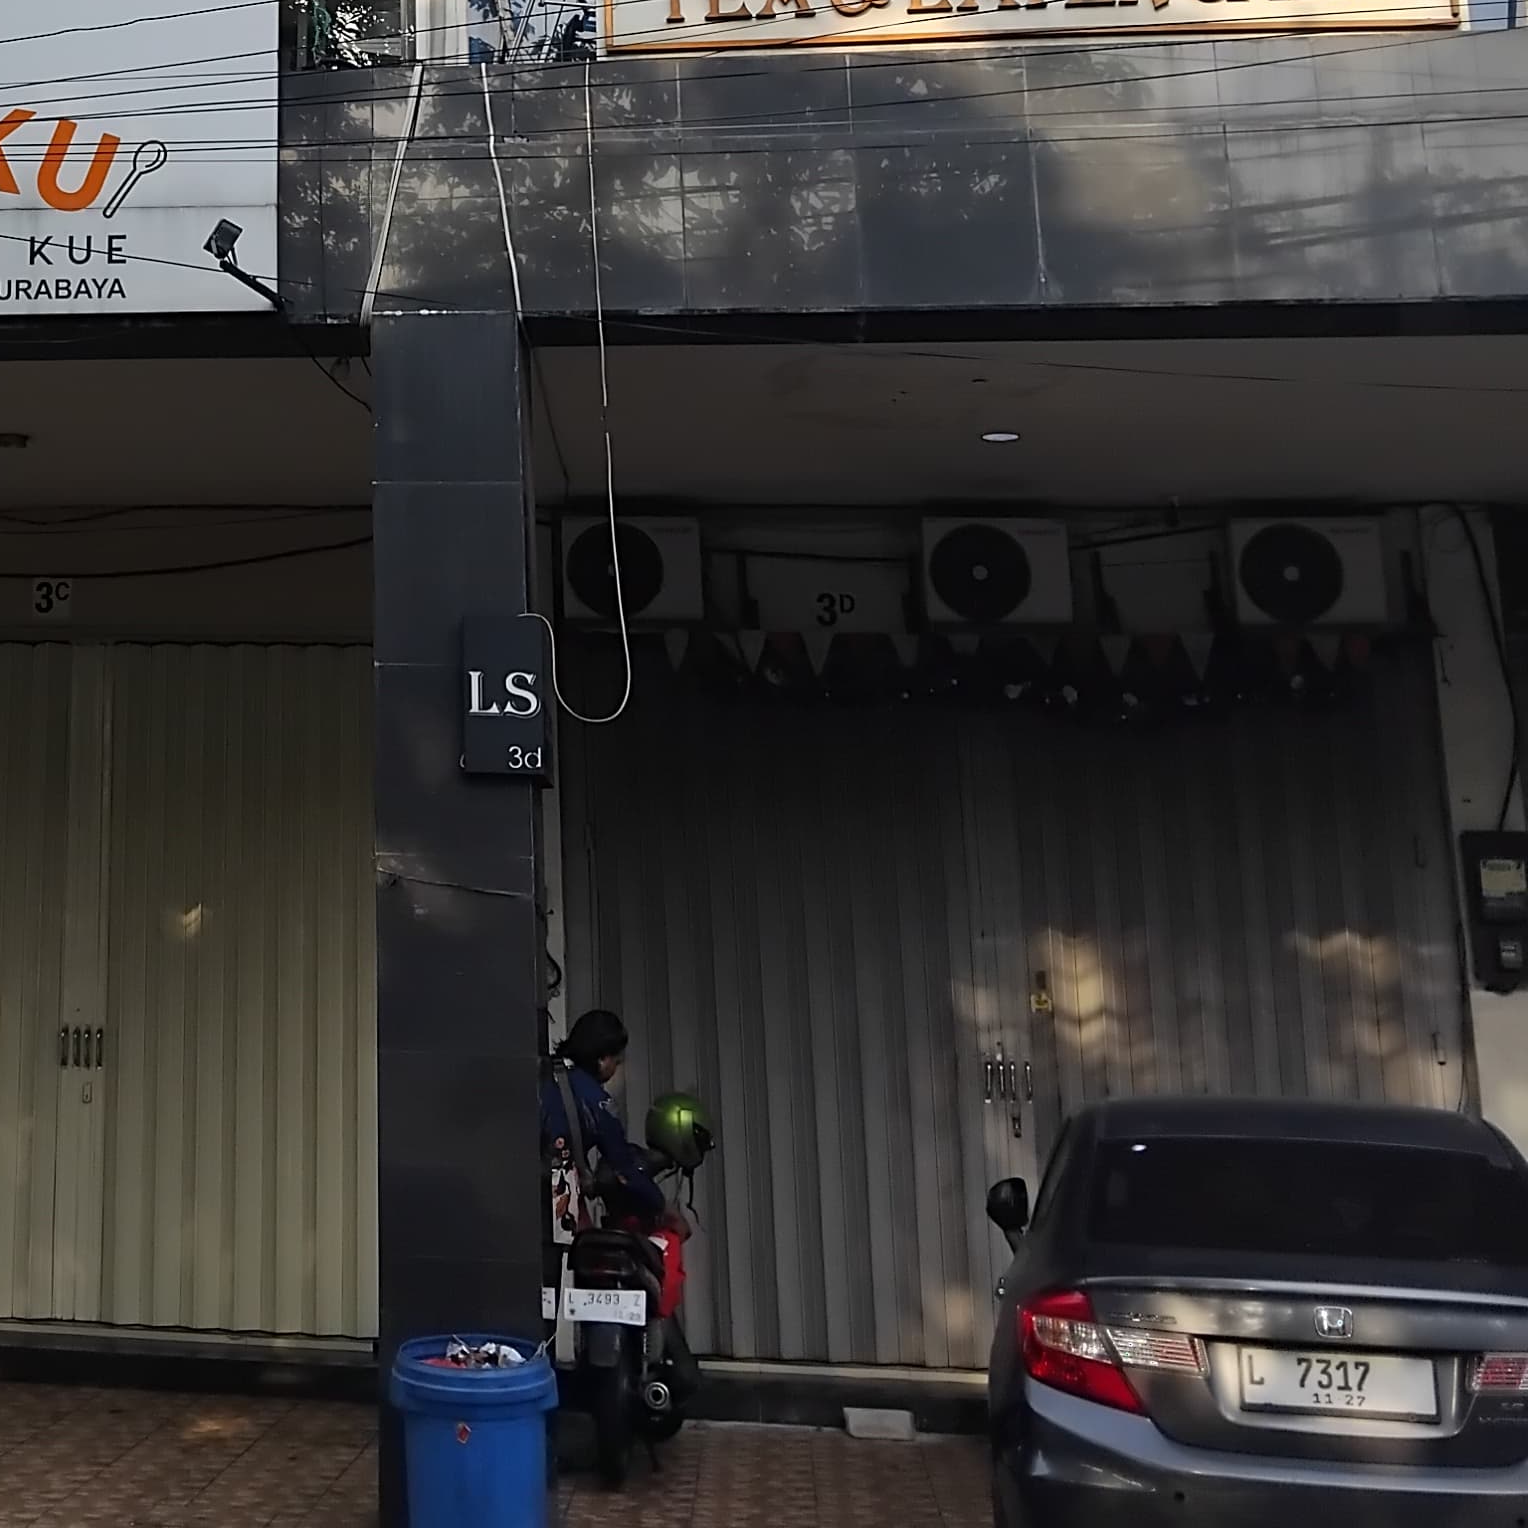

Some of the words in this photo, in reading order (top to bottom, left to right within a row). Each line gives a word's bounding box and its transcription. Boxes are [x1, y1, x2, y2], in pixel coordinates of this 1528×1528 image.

[28, 233, 128, 266] KUE
[34, 581, 70, 614] 3C
[816, 593, 855, 625] 3D
[467, 670, 542, 719] LS
[508, 745, 542, 769] 3d
[1248, 1354, 1265, 1386] L
[1297, 1357, 1370, 1391] 7317
[1312, 1392, 1333, 1404] 11
[1345, 1393, 1366, 1407] 27
